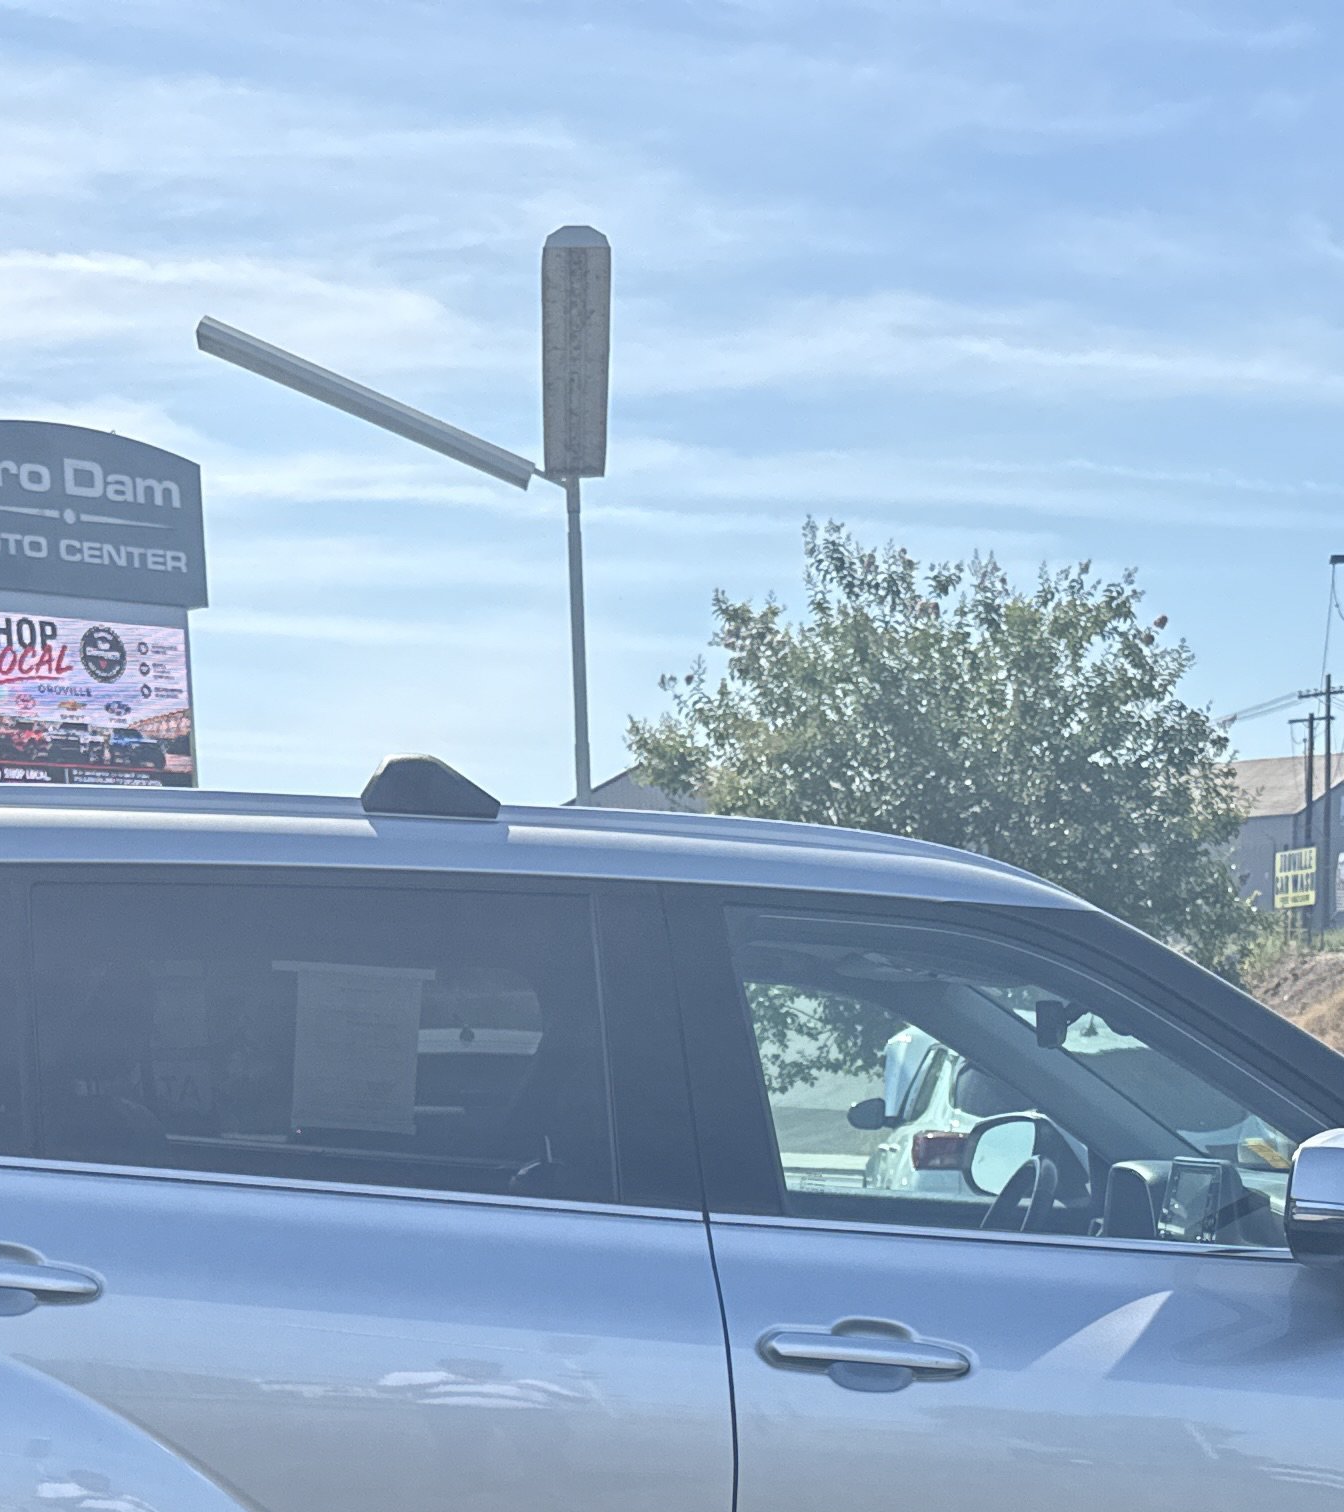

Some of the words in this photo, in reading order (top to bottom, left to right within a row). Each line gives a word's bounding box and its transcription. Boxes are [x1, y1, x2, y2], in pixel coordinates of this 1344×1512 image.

[63, 457, 182, 509] Dam
[59, 539, 188, 573] CENTER
[37, 683, 93, 698] OROVILLE
